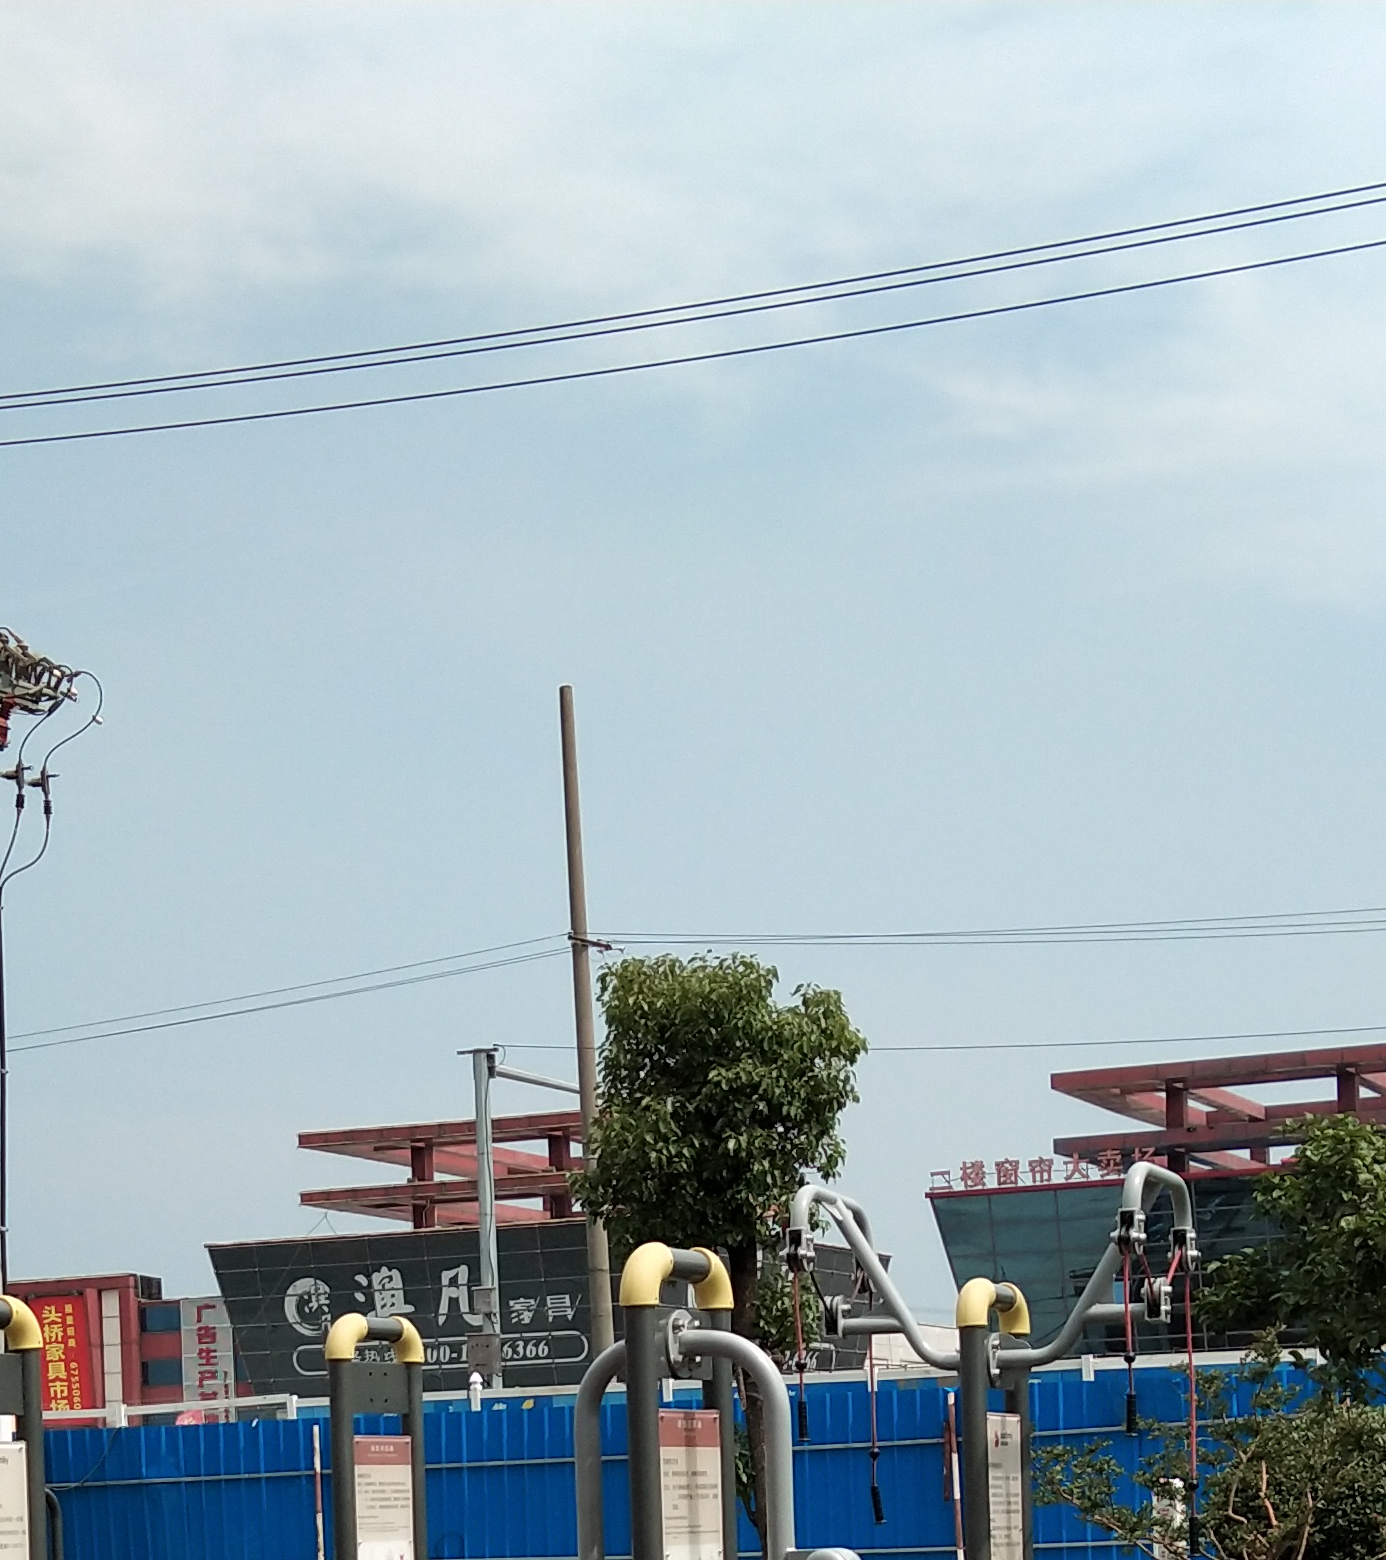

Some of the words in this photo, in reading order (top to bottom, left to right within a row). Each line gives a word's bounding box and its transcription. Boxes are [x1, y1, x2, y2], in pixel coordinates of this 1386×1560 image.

[929, 1147, 1156, 1190] 二楼窗帘大卖场
